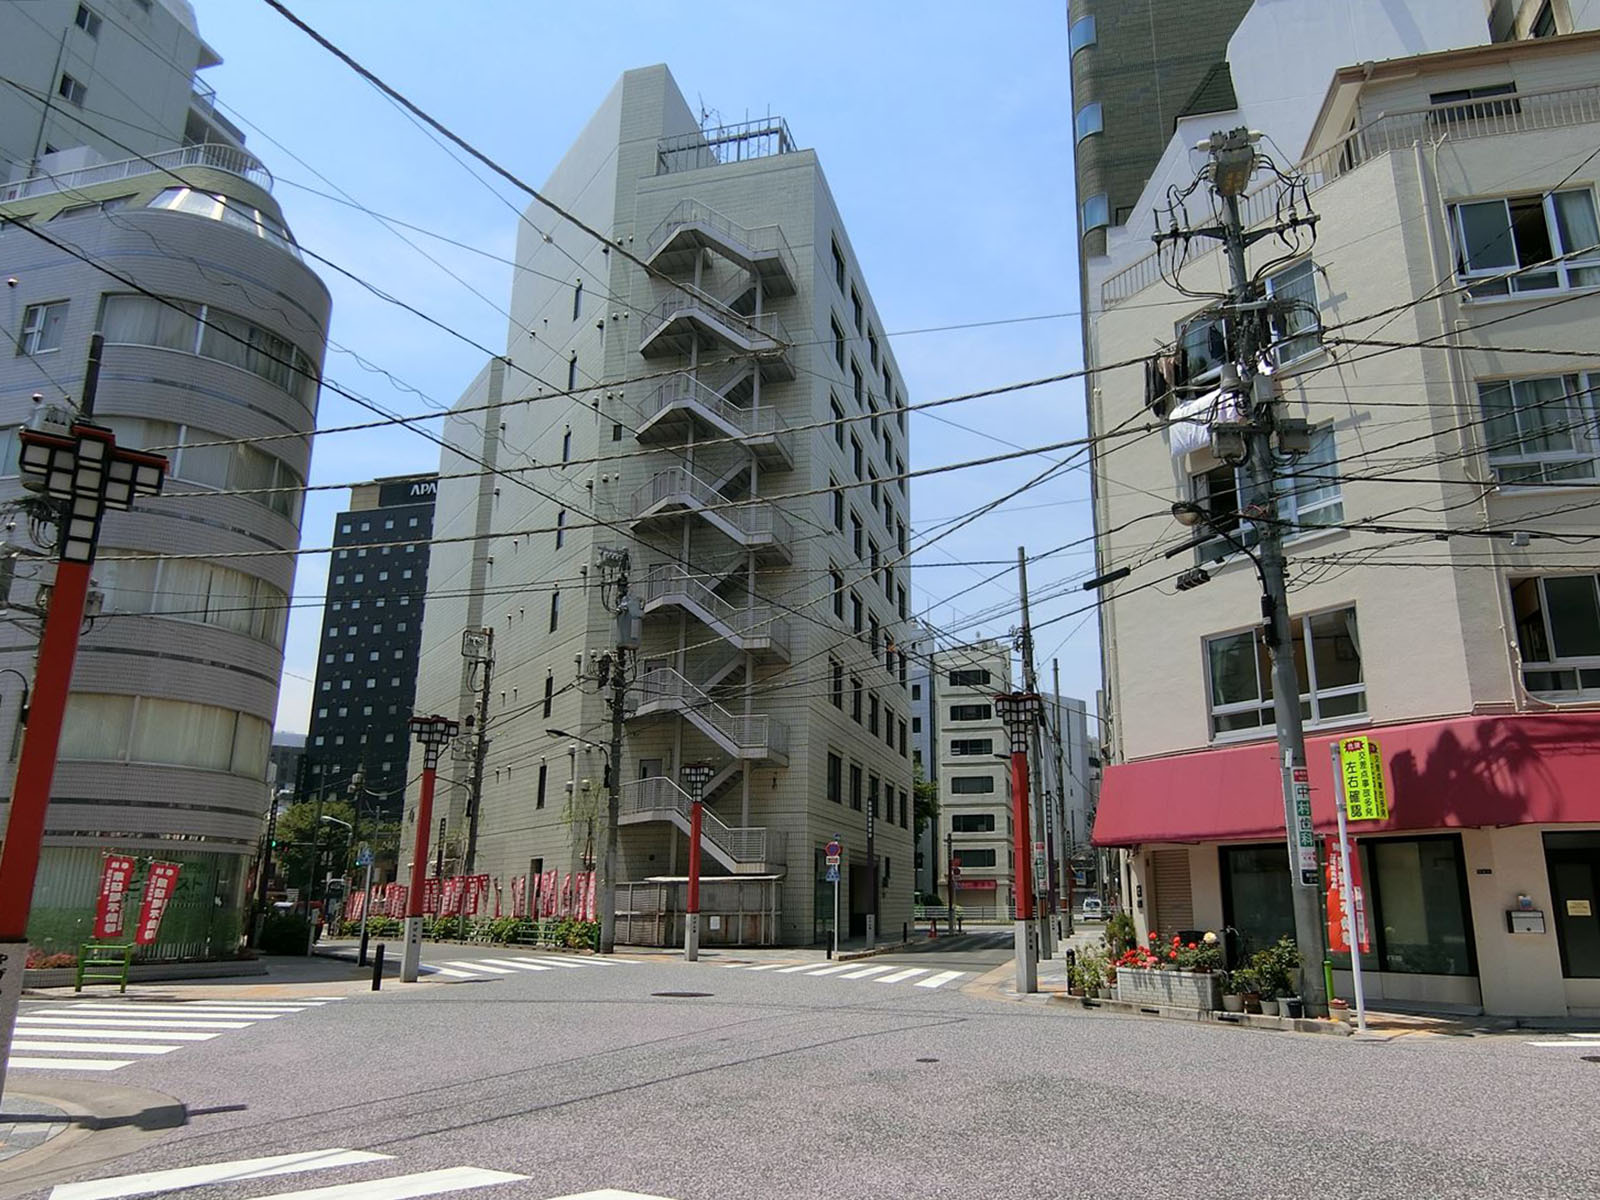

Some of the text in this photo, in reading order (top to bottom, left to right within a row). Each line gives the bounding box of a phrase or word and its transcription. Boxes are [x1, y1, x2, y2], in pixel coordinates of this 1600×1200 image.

[410, 482, 437, 496] APA
[1297, 785, 1315, 847] 中村歯科
[1345, 761, 1362, 818] 左右確認
